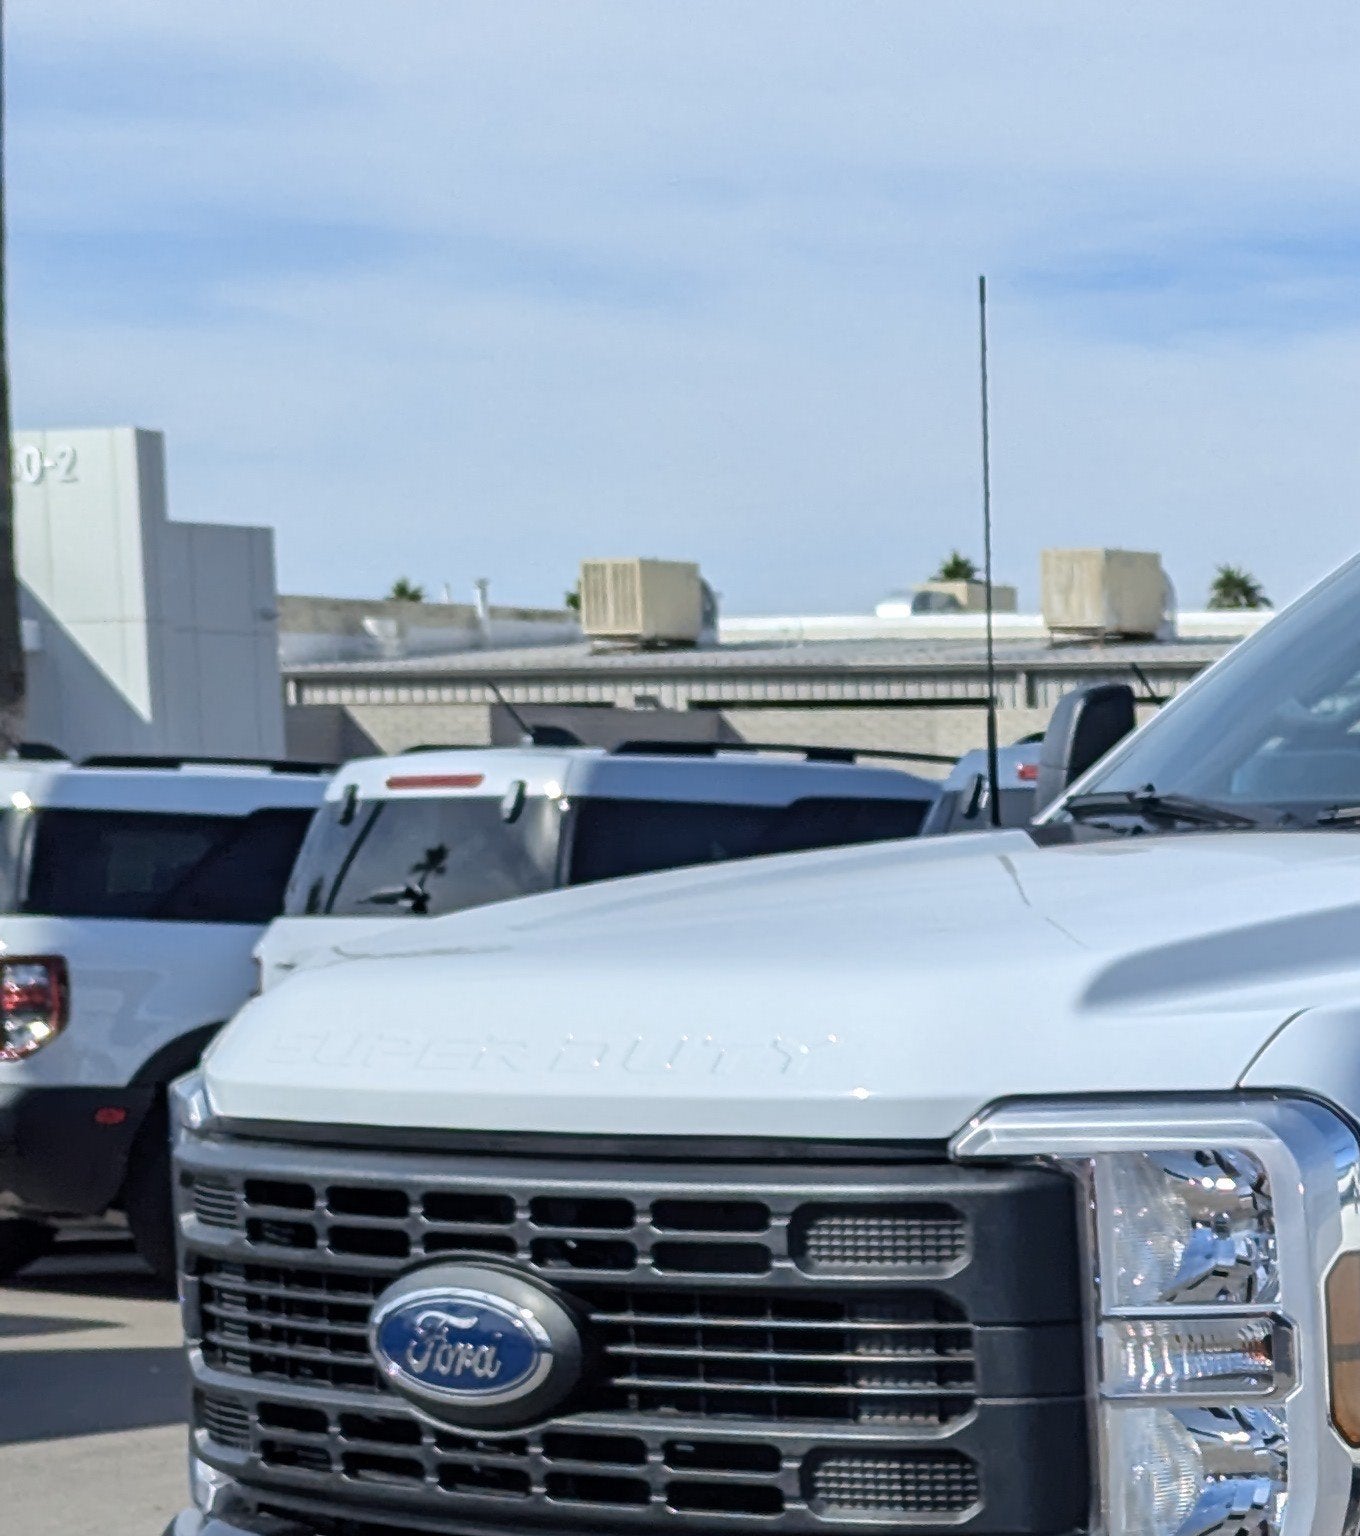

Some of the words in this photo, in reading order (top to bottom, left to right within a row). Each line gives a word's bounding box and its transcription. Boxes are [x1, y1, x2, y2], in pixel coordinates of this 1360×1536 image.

[264, 1030, 530, 1073] SUPER
[546, 1032, 840, 1076] DUTY
[404, 1309, 502, 1379] Ford
